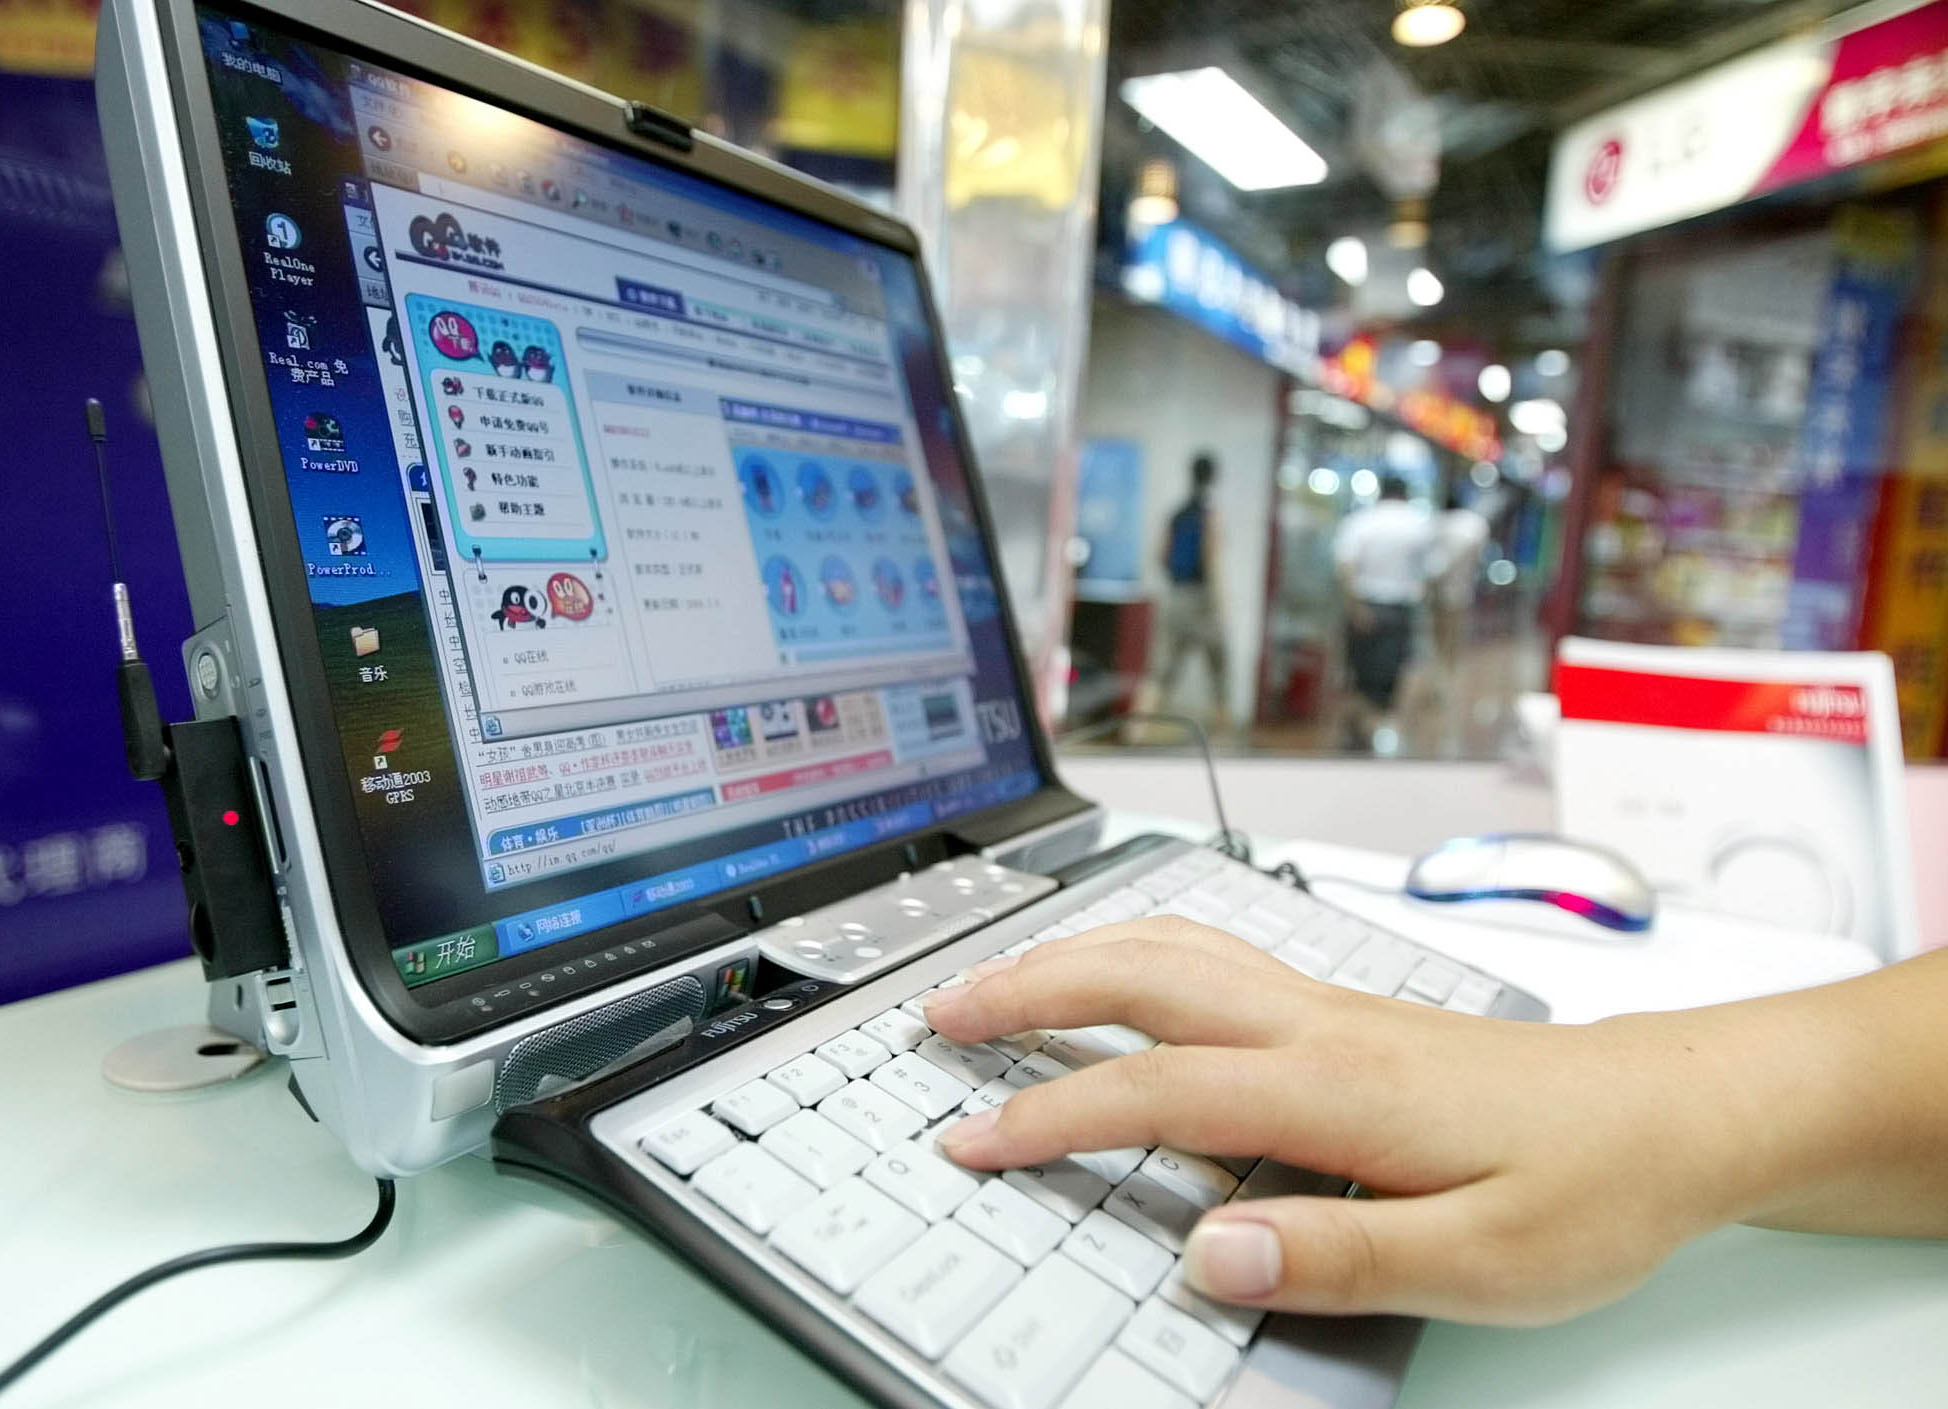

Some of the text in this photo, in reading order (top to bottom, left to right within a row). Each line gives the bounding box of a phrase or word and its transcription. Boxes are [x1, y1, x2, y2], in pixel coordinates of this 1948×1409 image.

[222, 52, 281, 82] 我的电脑
[249, 151, 291, 176] 回收站
[263, 251, 315, 273] RealOne
[270, 267, 314, 286] Player
[435, 316, 459, 339] QQ
[300, 457, 359, 473] PowerDVD
[491, 472, 540, 489] 特色功能
[553, 578, 573, 597] QQ
[359, 665, 389, 683] 音乐
[360, 770, 432, 794] 移动通2003
[386, 789, 415, 805] GPRS
[535, 909, 582, 935] 网络连接
[435, 935, 477, 969] 开始
[701, 1012, 758, 1038] FUJITSU
[1021, 1065, 1044, 1080] R
[914, 1080, 931, 1094] 3
[863, 1109, 884, 1124] 2
[1159, 1156, 1182, 1172] C
[1122, 1191, 1149, 1210] X
[980, 1202, 1001, 1219] A
[1081, 1233, 1108, 1252] Z
